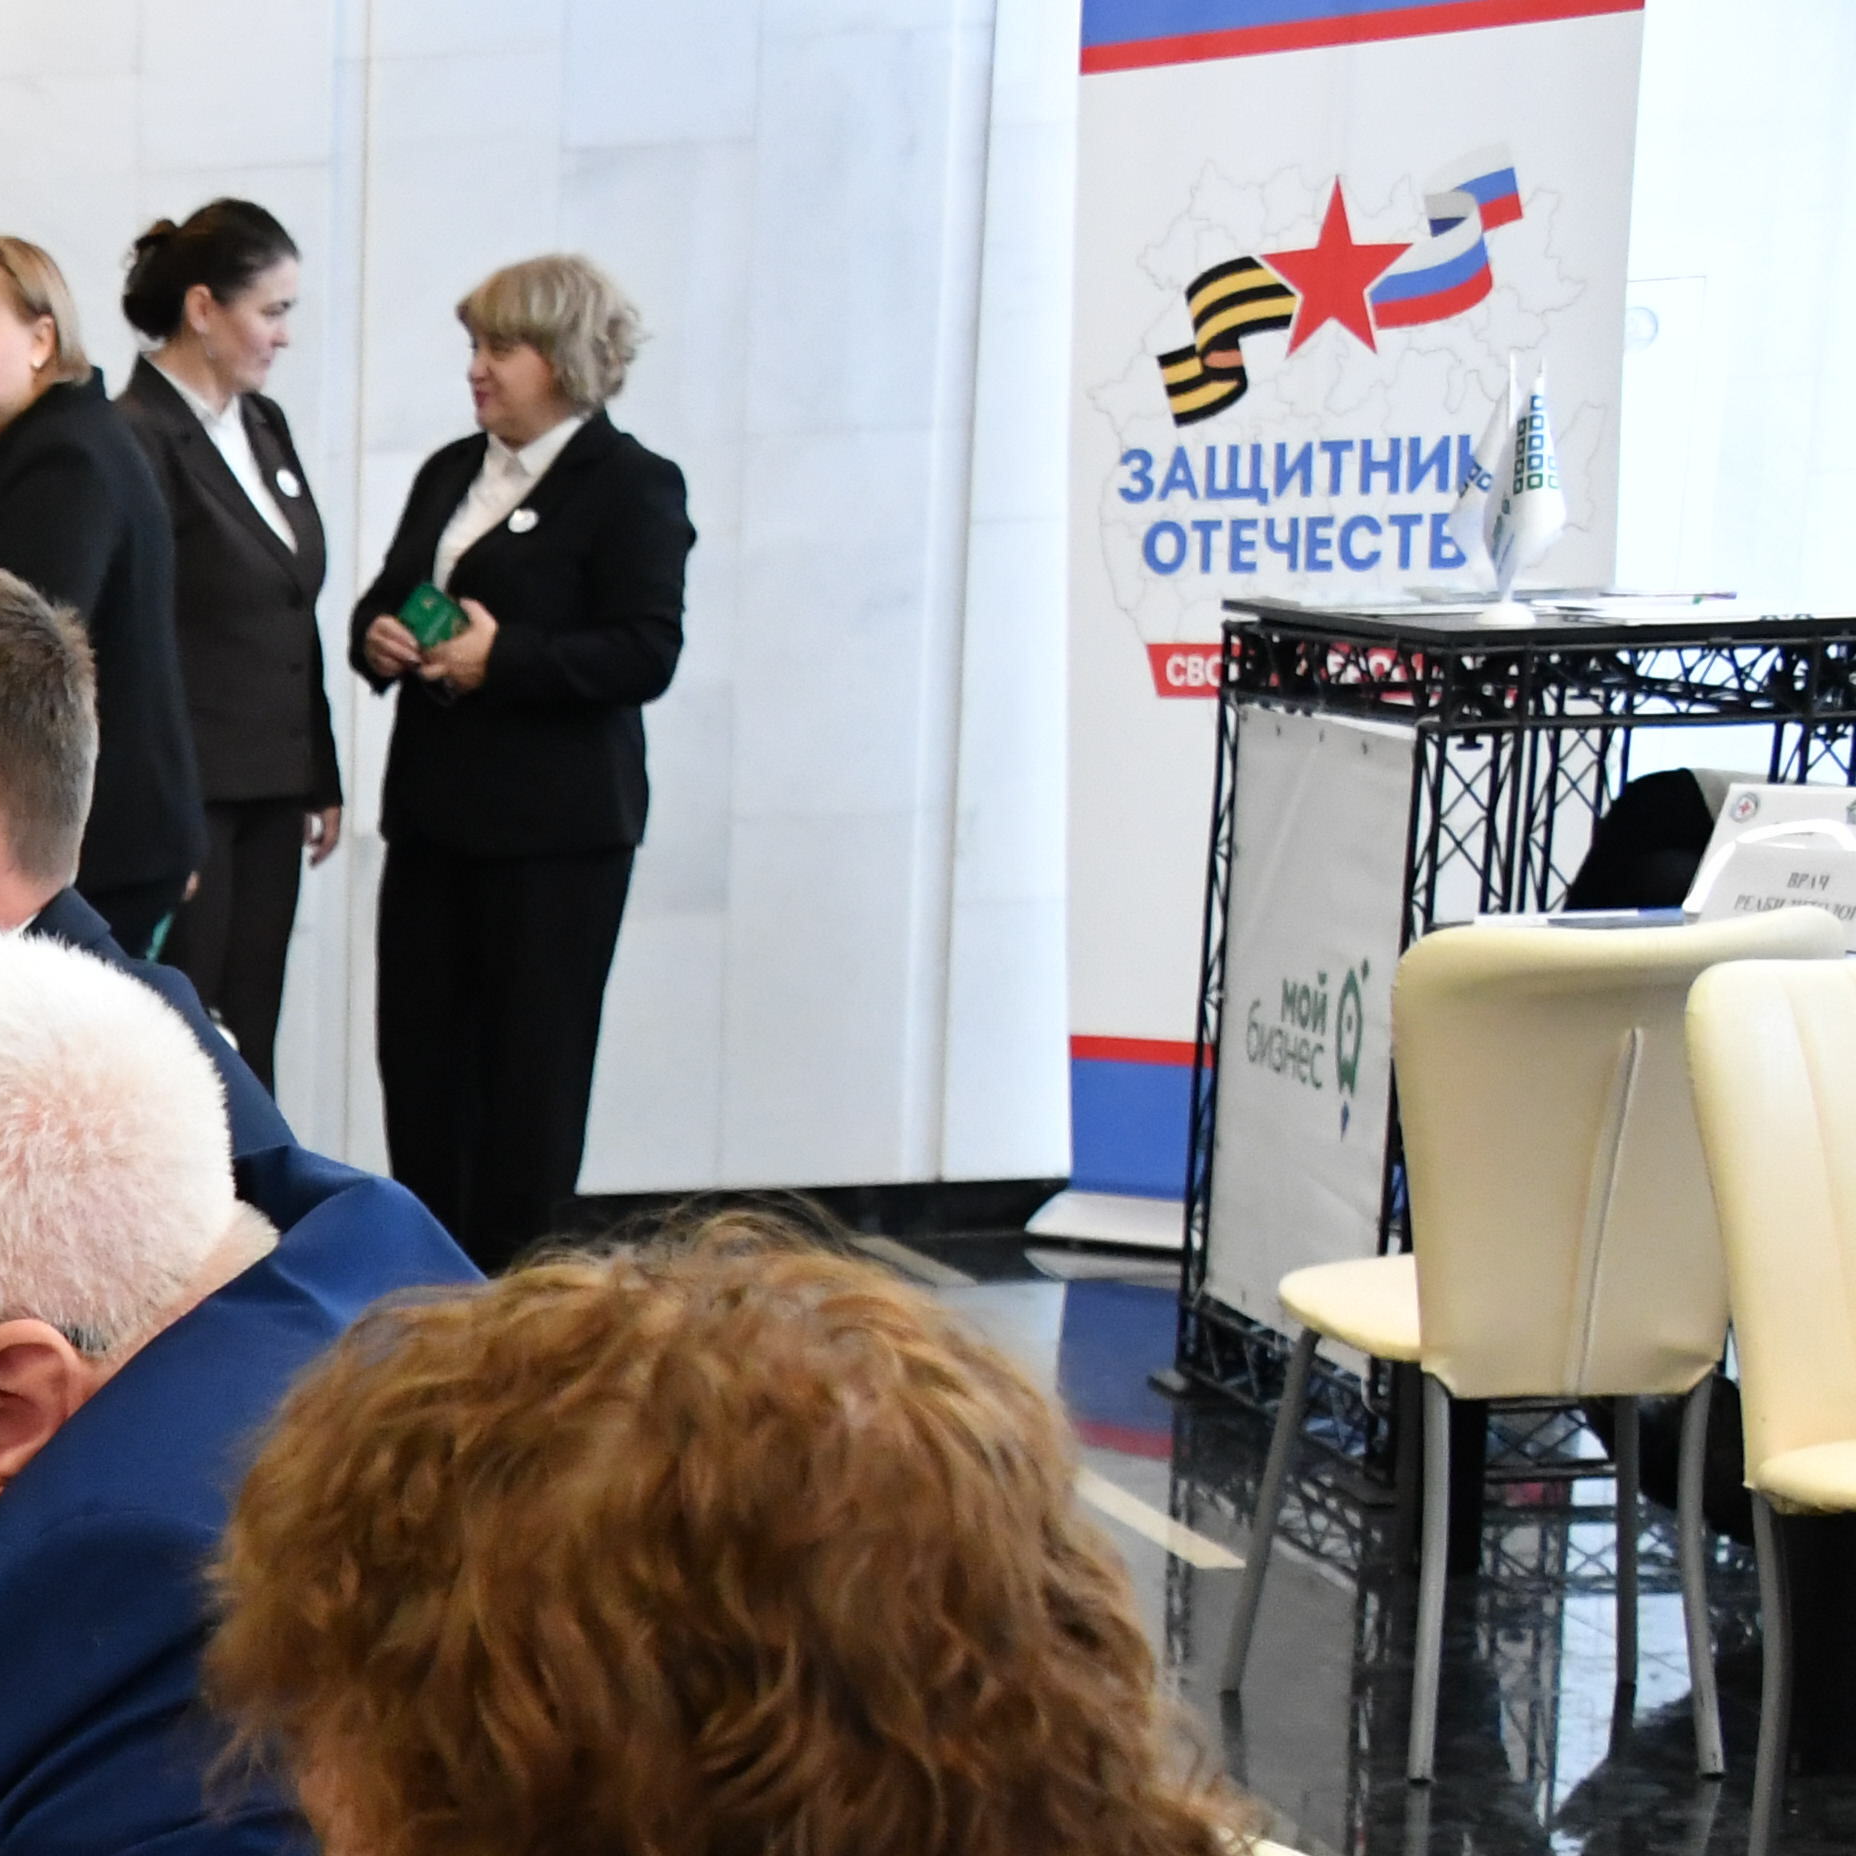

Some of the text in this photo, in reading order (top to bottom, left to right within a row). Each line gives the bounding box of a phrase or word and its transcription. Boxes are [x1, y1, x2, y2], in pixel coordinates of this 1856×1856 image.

[1118, 433, 1473, 506] ЗАЩИТНИ
[1142, 512, 1469, 576] ОТЕЧЕСТВ
[1245, 1000, 1325, 1090] бизнес
